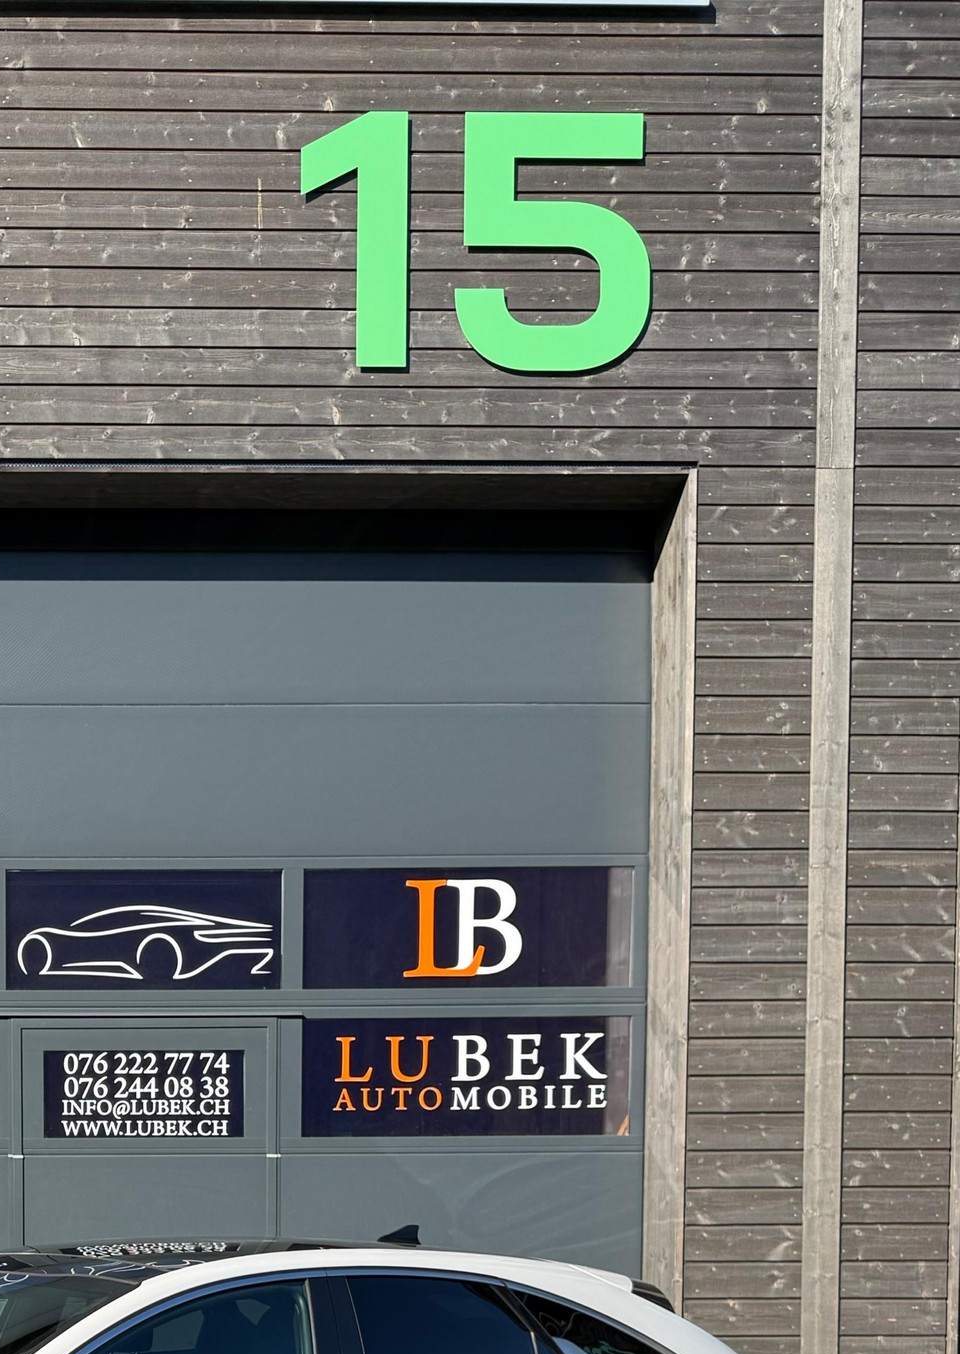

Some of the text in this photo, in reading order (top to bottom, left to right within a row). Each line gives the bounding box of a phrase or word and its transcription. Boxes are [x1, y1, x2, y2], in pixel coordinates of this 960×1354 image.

[301, 111, 651, 371] 15
[403, 878, 523, 978] LB
[63, 1052, 230, 1074] 076 222 77 74
[335, 1033, 608, 1082] LUBEK
[63, 1076, 229, 1099] 076 244 08 38
[333, 1084, 608, 1112] AUTOMOBILE
[61, 1099, 230, 1119] INFO@LUBEK.CH
[61, 1120, 229, 1136] WWW.LUBEK.CH
